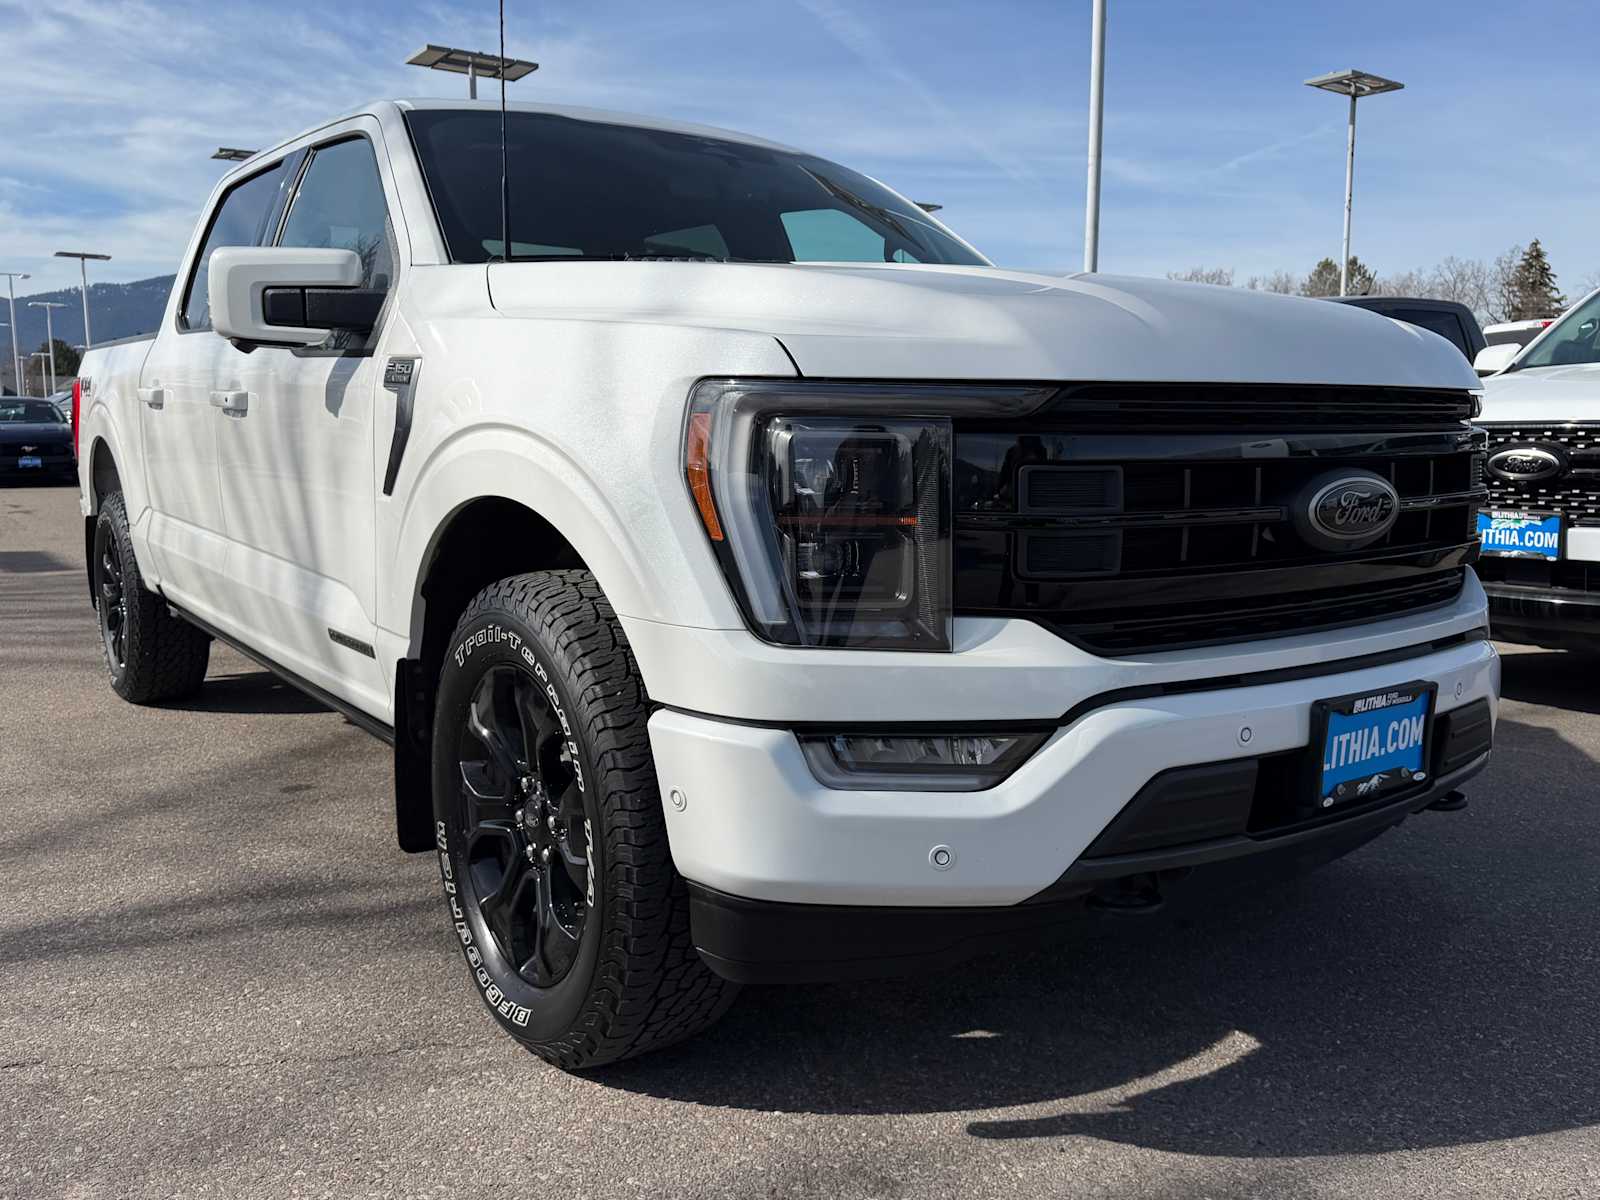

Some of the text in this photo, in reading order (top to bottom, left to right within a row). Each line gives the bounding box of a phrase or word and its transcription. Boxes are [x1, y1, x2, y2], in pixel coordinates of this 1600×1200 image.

[1504, 455, 1542, 472] Ford
[1335, 491, 1386, 525] Ford
[1481, 528, 1559, 548] ITHIA.COM
[454, 624, 585, 793] Trail-Terrain
[436, 821, 534, 1027] BFGoodrich
